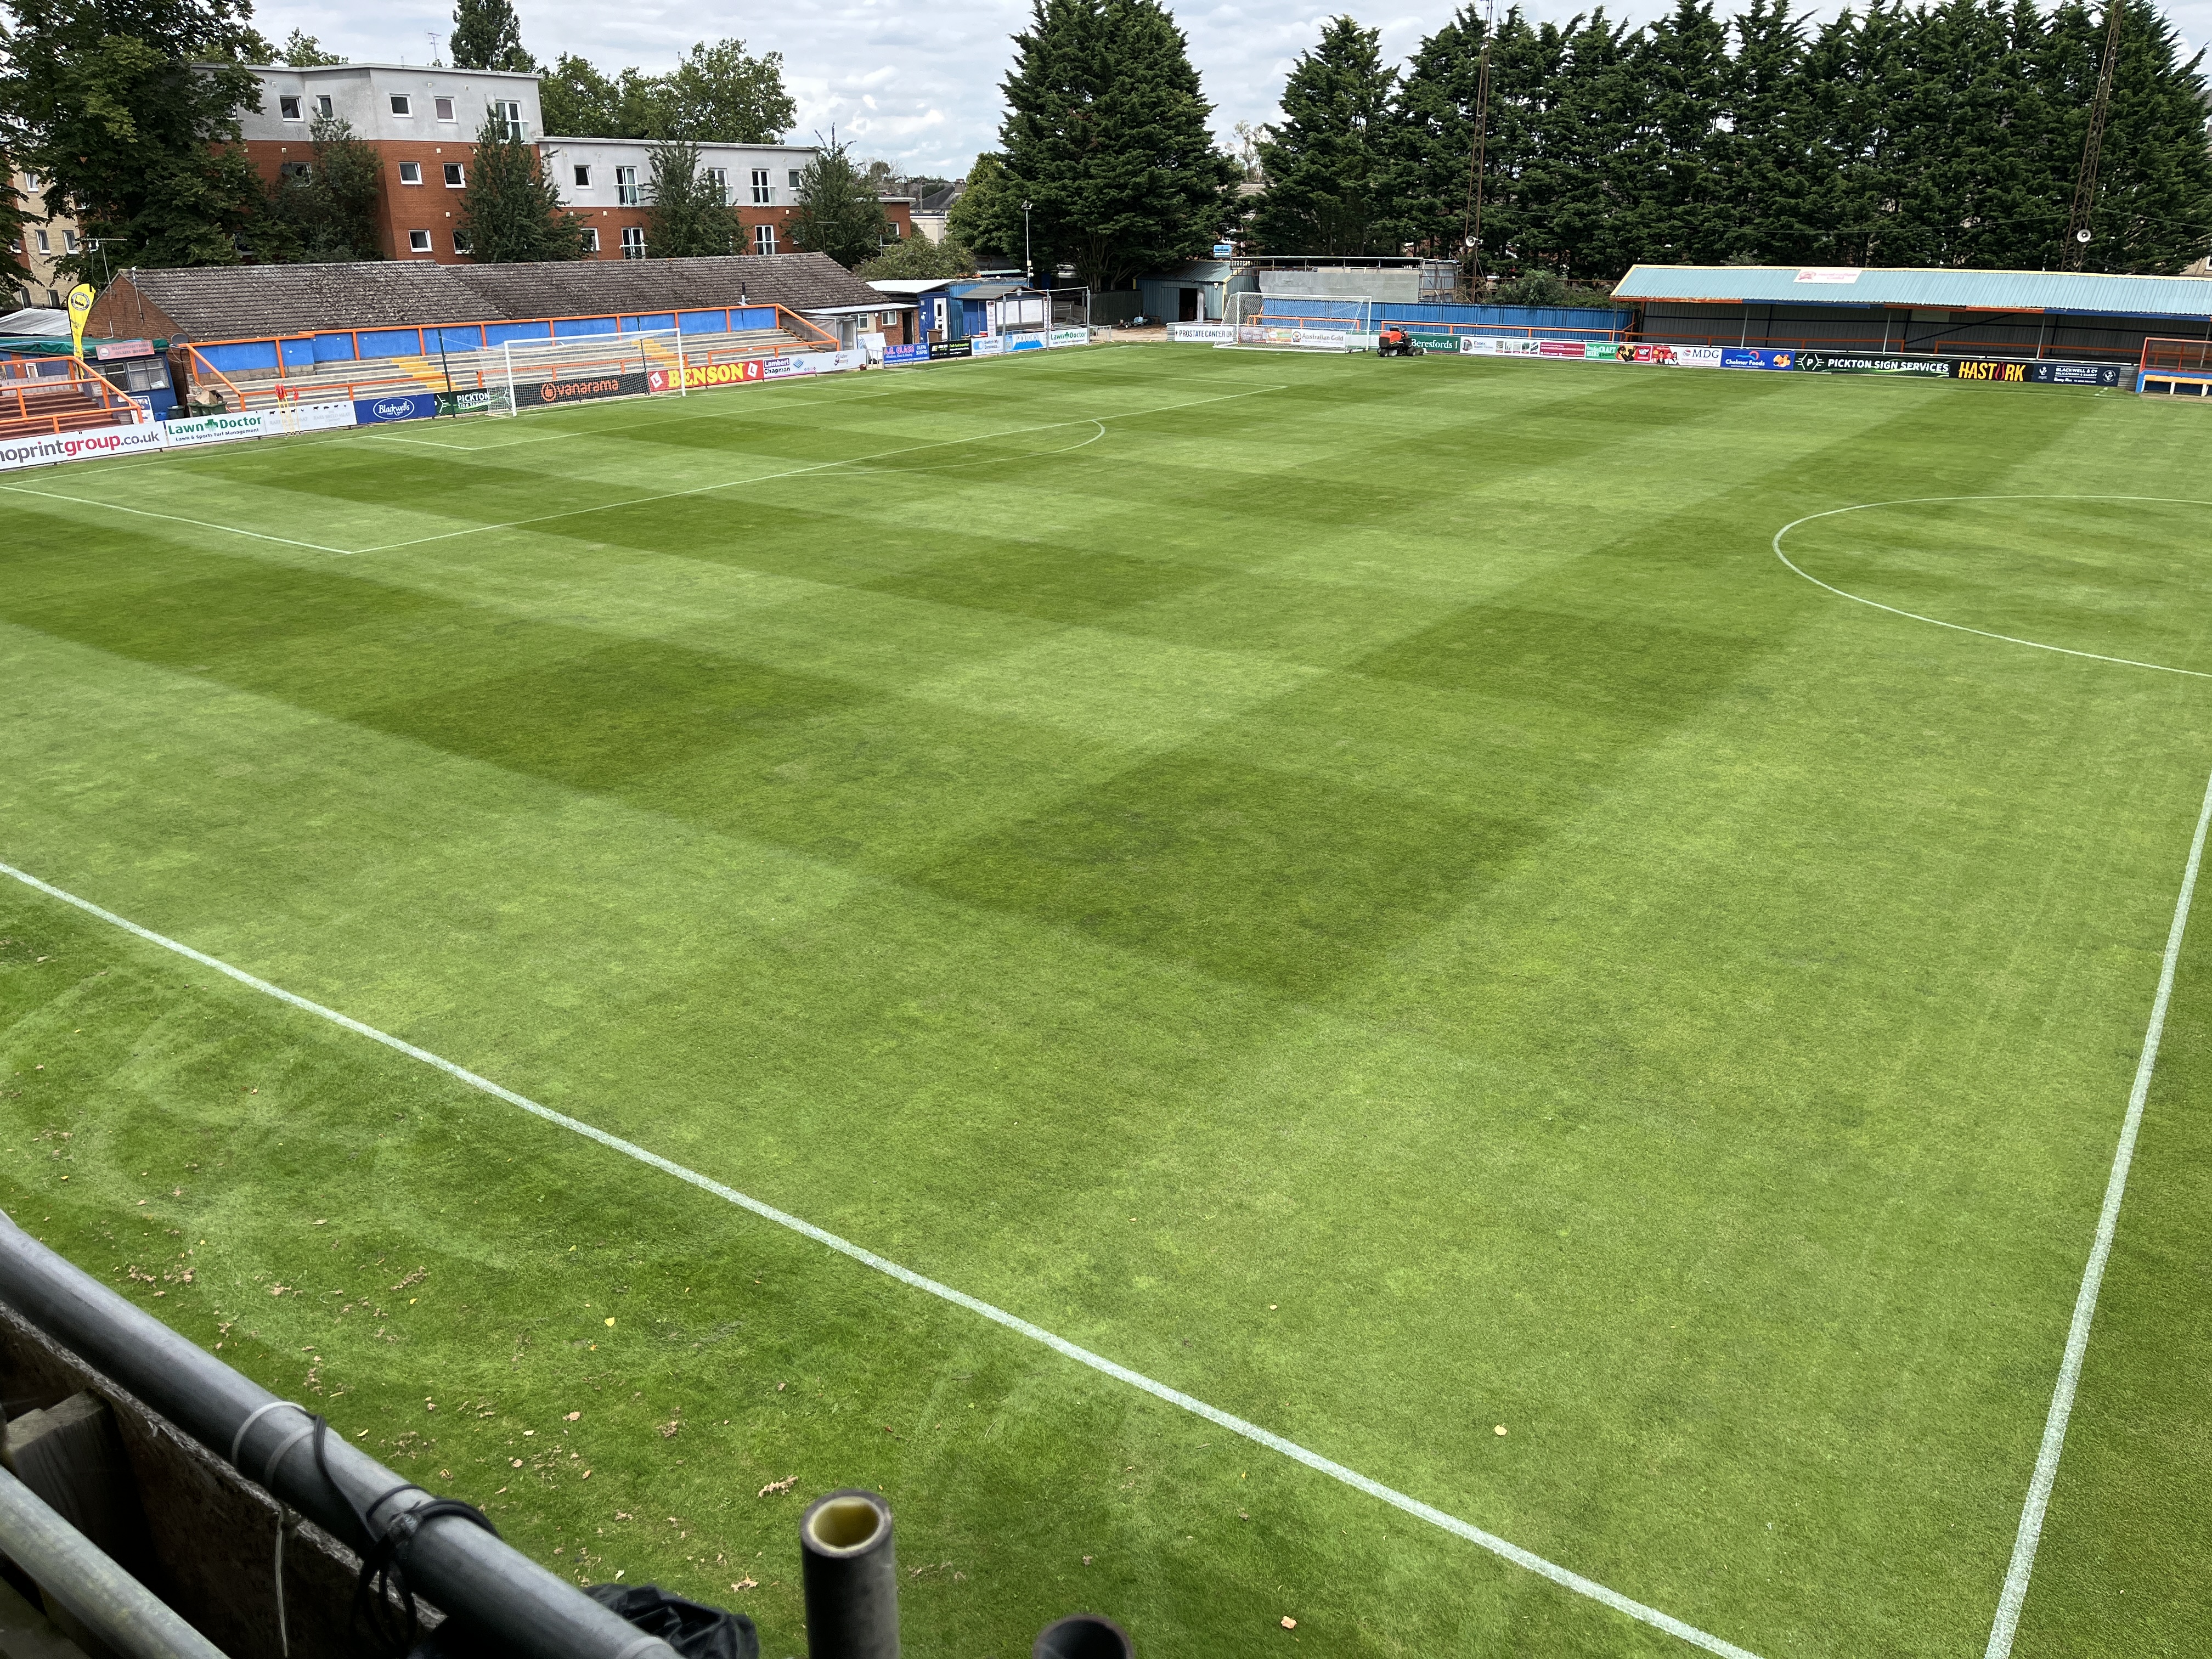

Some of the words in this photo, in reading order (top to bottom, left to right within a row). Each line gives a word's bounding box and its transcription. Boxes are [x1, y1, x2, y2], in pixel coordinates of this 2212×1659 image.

[1302, 332, 1330, 341] Australian
[1412, 338, 1453, 348] Beresfords
[896, 345, 915, 354] GLASS
[1692, 349, 1719, 359] MDG
[764, 358, 789, 368] Lambert
[1807, 358, 1814, 366] P
[1827, 358, 1872, 369] PICKTON
[1874, 359, 1898, 370] SIGN
[1900, 361, 1949, 372] SERVICES
[667, 363, 744, 388] BENSON
[764, 366, 791, 375] Chapman
[557, 379, 619, 395] vanarama
[456, 392, 490, 403] PICKTON
[378, 401, 410, 416] Blackwells
[168, 423, 204, 435] Lawn
[219, 416, 261, 429] Doctor
